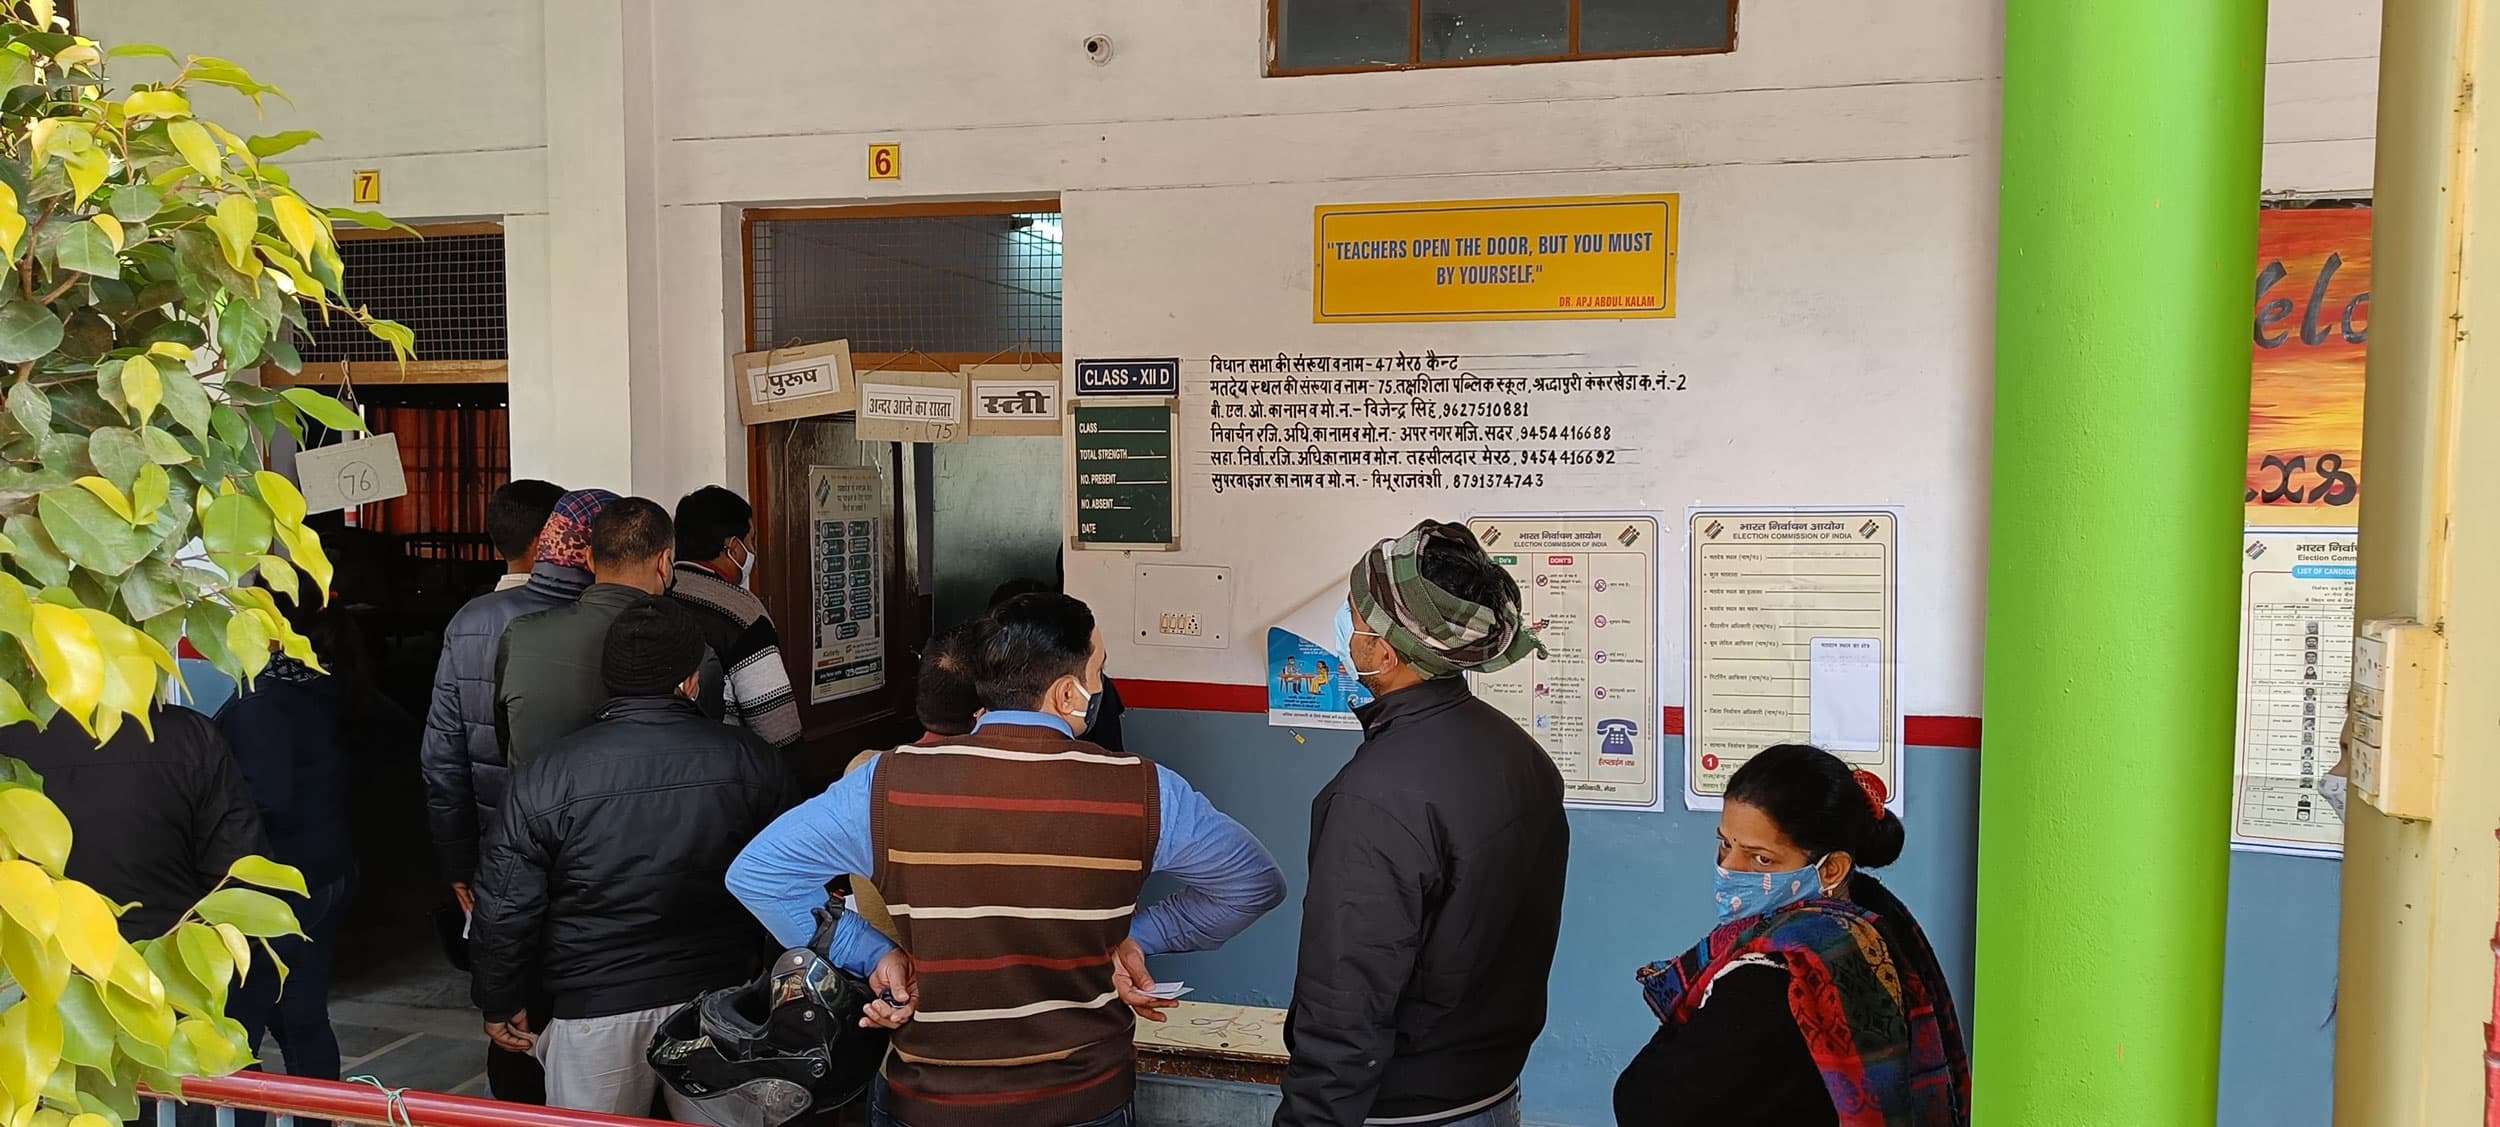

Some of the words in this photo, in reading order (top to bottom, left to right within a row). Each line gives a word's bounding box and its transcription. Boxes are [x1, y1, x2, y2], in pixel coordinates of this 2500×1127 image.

[875, 149, 892, 175] 6
[359, 176, 373, 200] 7
[1327, 240, 1407, 260] "TEACHERS
[1413, 238, 1450, 258] OPEN
[1455, 238, 1481, 257] THE
[1487, 236, 1534, 257] DOOR,
[1538, 235, 1568, 255] BUT
[1574, 234, 1602, 253] YOU
[1608, 232, 1652, 252] MUST
[1436, 267, 1455, 286] BY
[1459, 264, 1543, 285] YOURSELF."
[1559, 296, 1573, 307] DR.
[1576, 296, 1593, 307] APJ
[1594, 296, 1623, 307] ABDUL
[1625, 296, 1656, 307] KALAM
[1085, 368, 1129, 386] CLASS
[1141, 368, 1156, 385] XII
[1160, 368, 1170, 385] D
[869, 398, 891, 415] अन्दर
[893, 397, 912, 415] आने
[915, 399, 927, 416] का
[929, 401, 951, 417] रास्ता
[980, 390, 1050, 414] स्त्री
[1443, 402, 1528, 417] 9627510881
[1079, 423, 1098, 434] CLASS
[1521, 426, 1610, 440] 9454416688
[1080, 450, 1097, 460] TOTAL
[1098, 449, 1128, 460] STRENGTH
[1080, 474, 1090, 484] NO.
[1091, 474, 1117, 484] PRESENT
[1454, 474, 1543, 488] 8791374743
[1081, 499, 1091, 509] NO.
[1092, 498, 1114, 509] ABSENT
[1082, 523, 1096, 534] DATE
[1740, 522, 1766, 531] भारत
[1768, 520, 1808, 531] निर्वाचन
[1810, 521, 1845, 531] आयोग
[2296, 543, 2325, 552] भारत
[1707, 757, 1713, 767] 1
